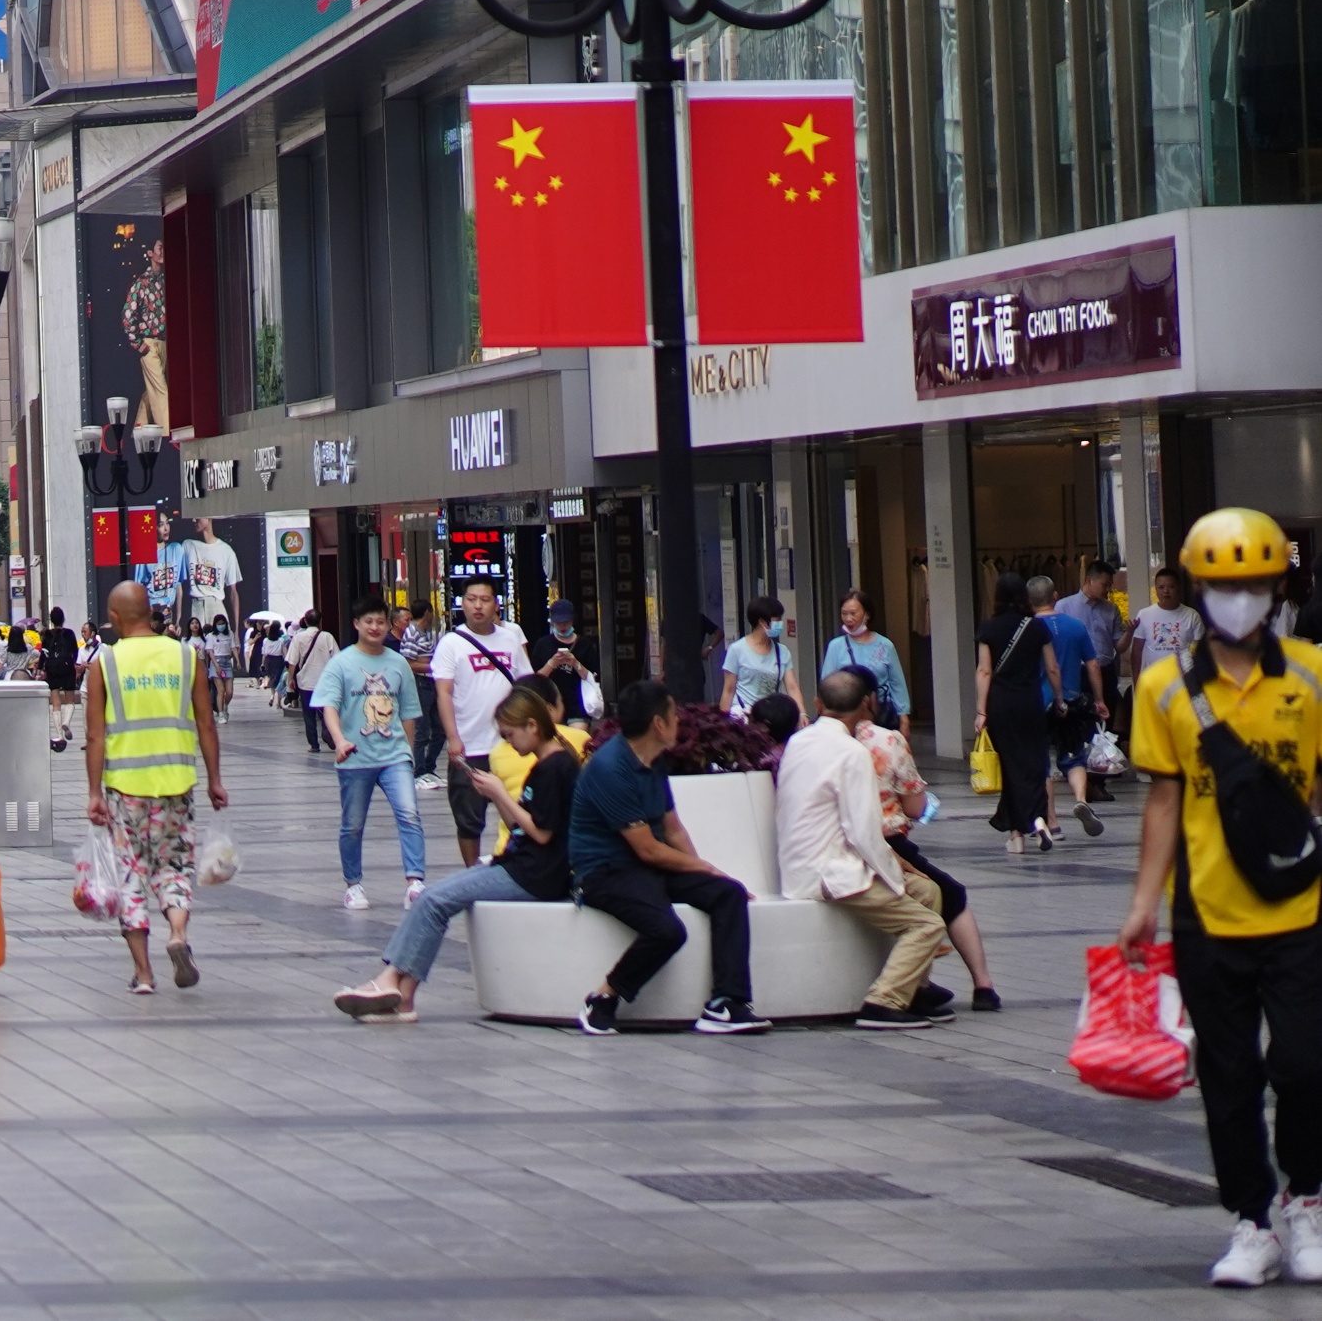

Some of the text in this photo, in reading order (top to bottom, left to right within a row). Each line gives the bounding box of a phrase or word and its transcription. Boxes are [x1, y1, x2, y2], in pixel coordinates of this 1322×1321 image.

[42, 155, 72, 194] GUCCI
[950, 294, 1109, 371] 周大福 CHOW TAI FOOK
[450, 408, 505, 471] HUAWEI
[184, 459, 234, 499] KFC TISSOT
